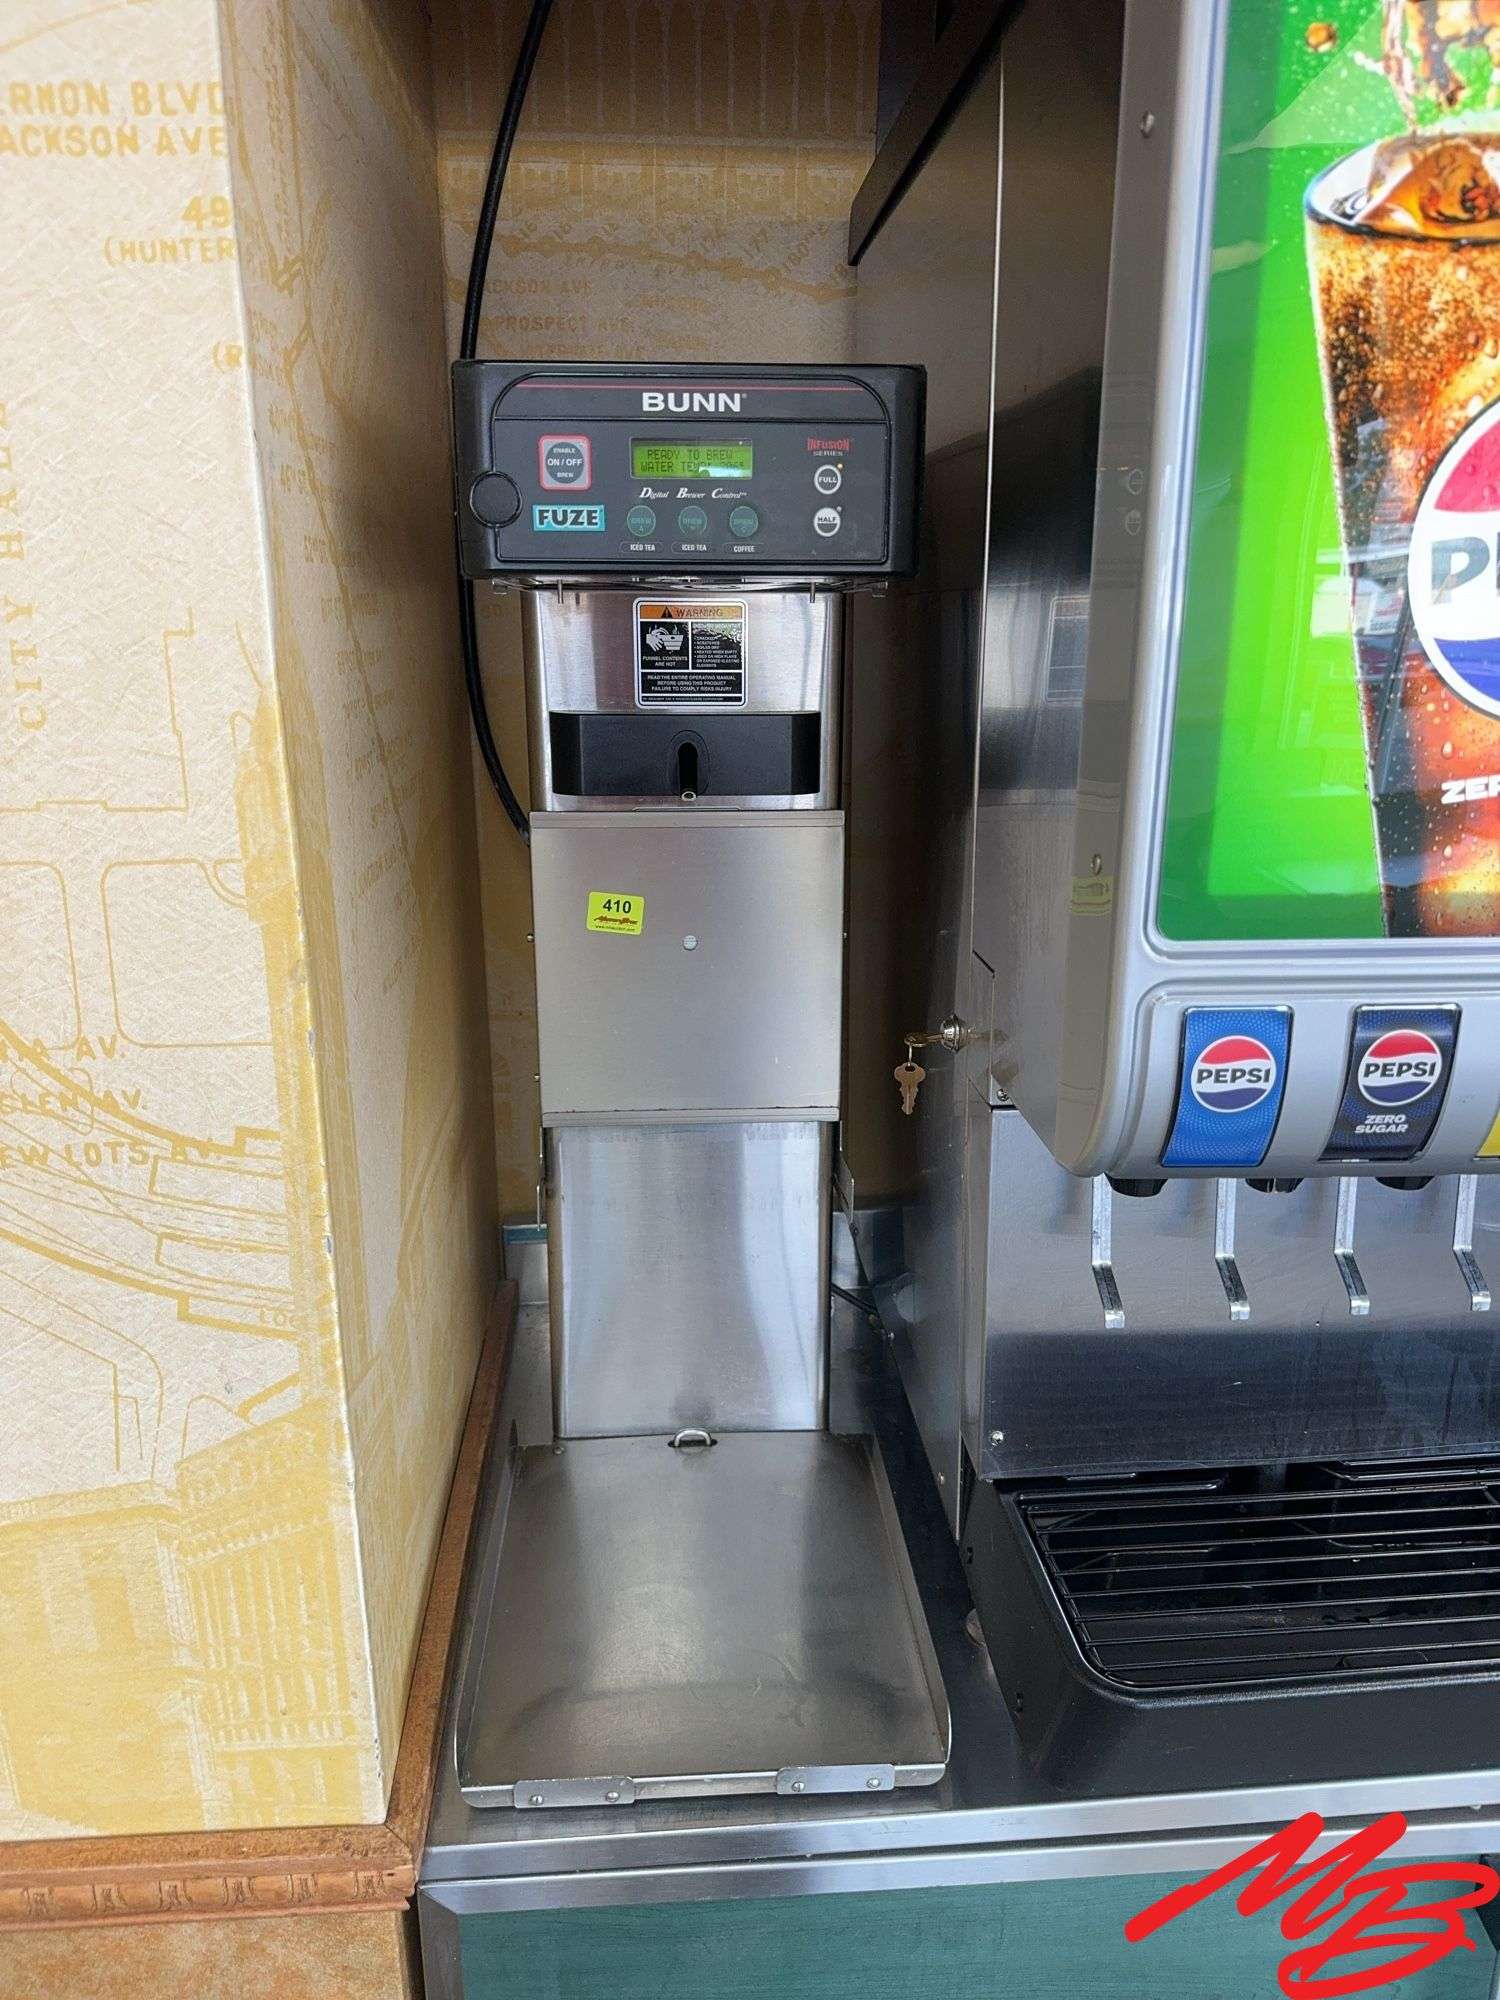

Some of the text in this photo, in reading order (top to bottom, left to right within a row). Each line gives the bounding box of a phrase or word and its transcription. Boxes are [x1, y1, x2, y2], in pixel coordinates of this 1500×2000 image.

[0, 82, 110, 116] RNON
[156, 126, 228, 156] AVE
[647, 449, 734, 461] READY TO BREW
[547, 458, 560, 466] ON
[566, 458, 583, 466] OFF
[640, 461, 673, 473] WATER
[536, 509, 600, 527] FUZE
[630, 543, 656, 551] ICED TEA
[696, 544, 707, 552] TEA
[733, 545, 755, 553] COFFEE
[676, 608, 723, 617] WARNING
[602, 899, 632, 914] 410
[1196, 1067, 1271, 1084] PEPSI
[1363, 1061, 1436, 1078] PEPSI
[1364, 1114, 1406, 1125] ZERO
[1354, 1124, 1409, 1134] SUGAR
